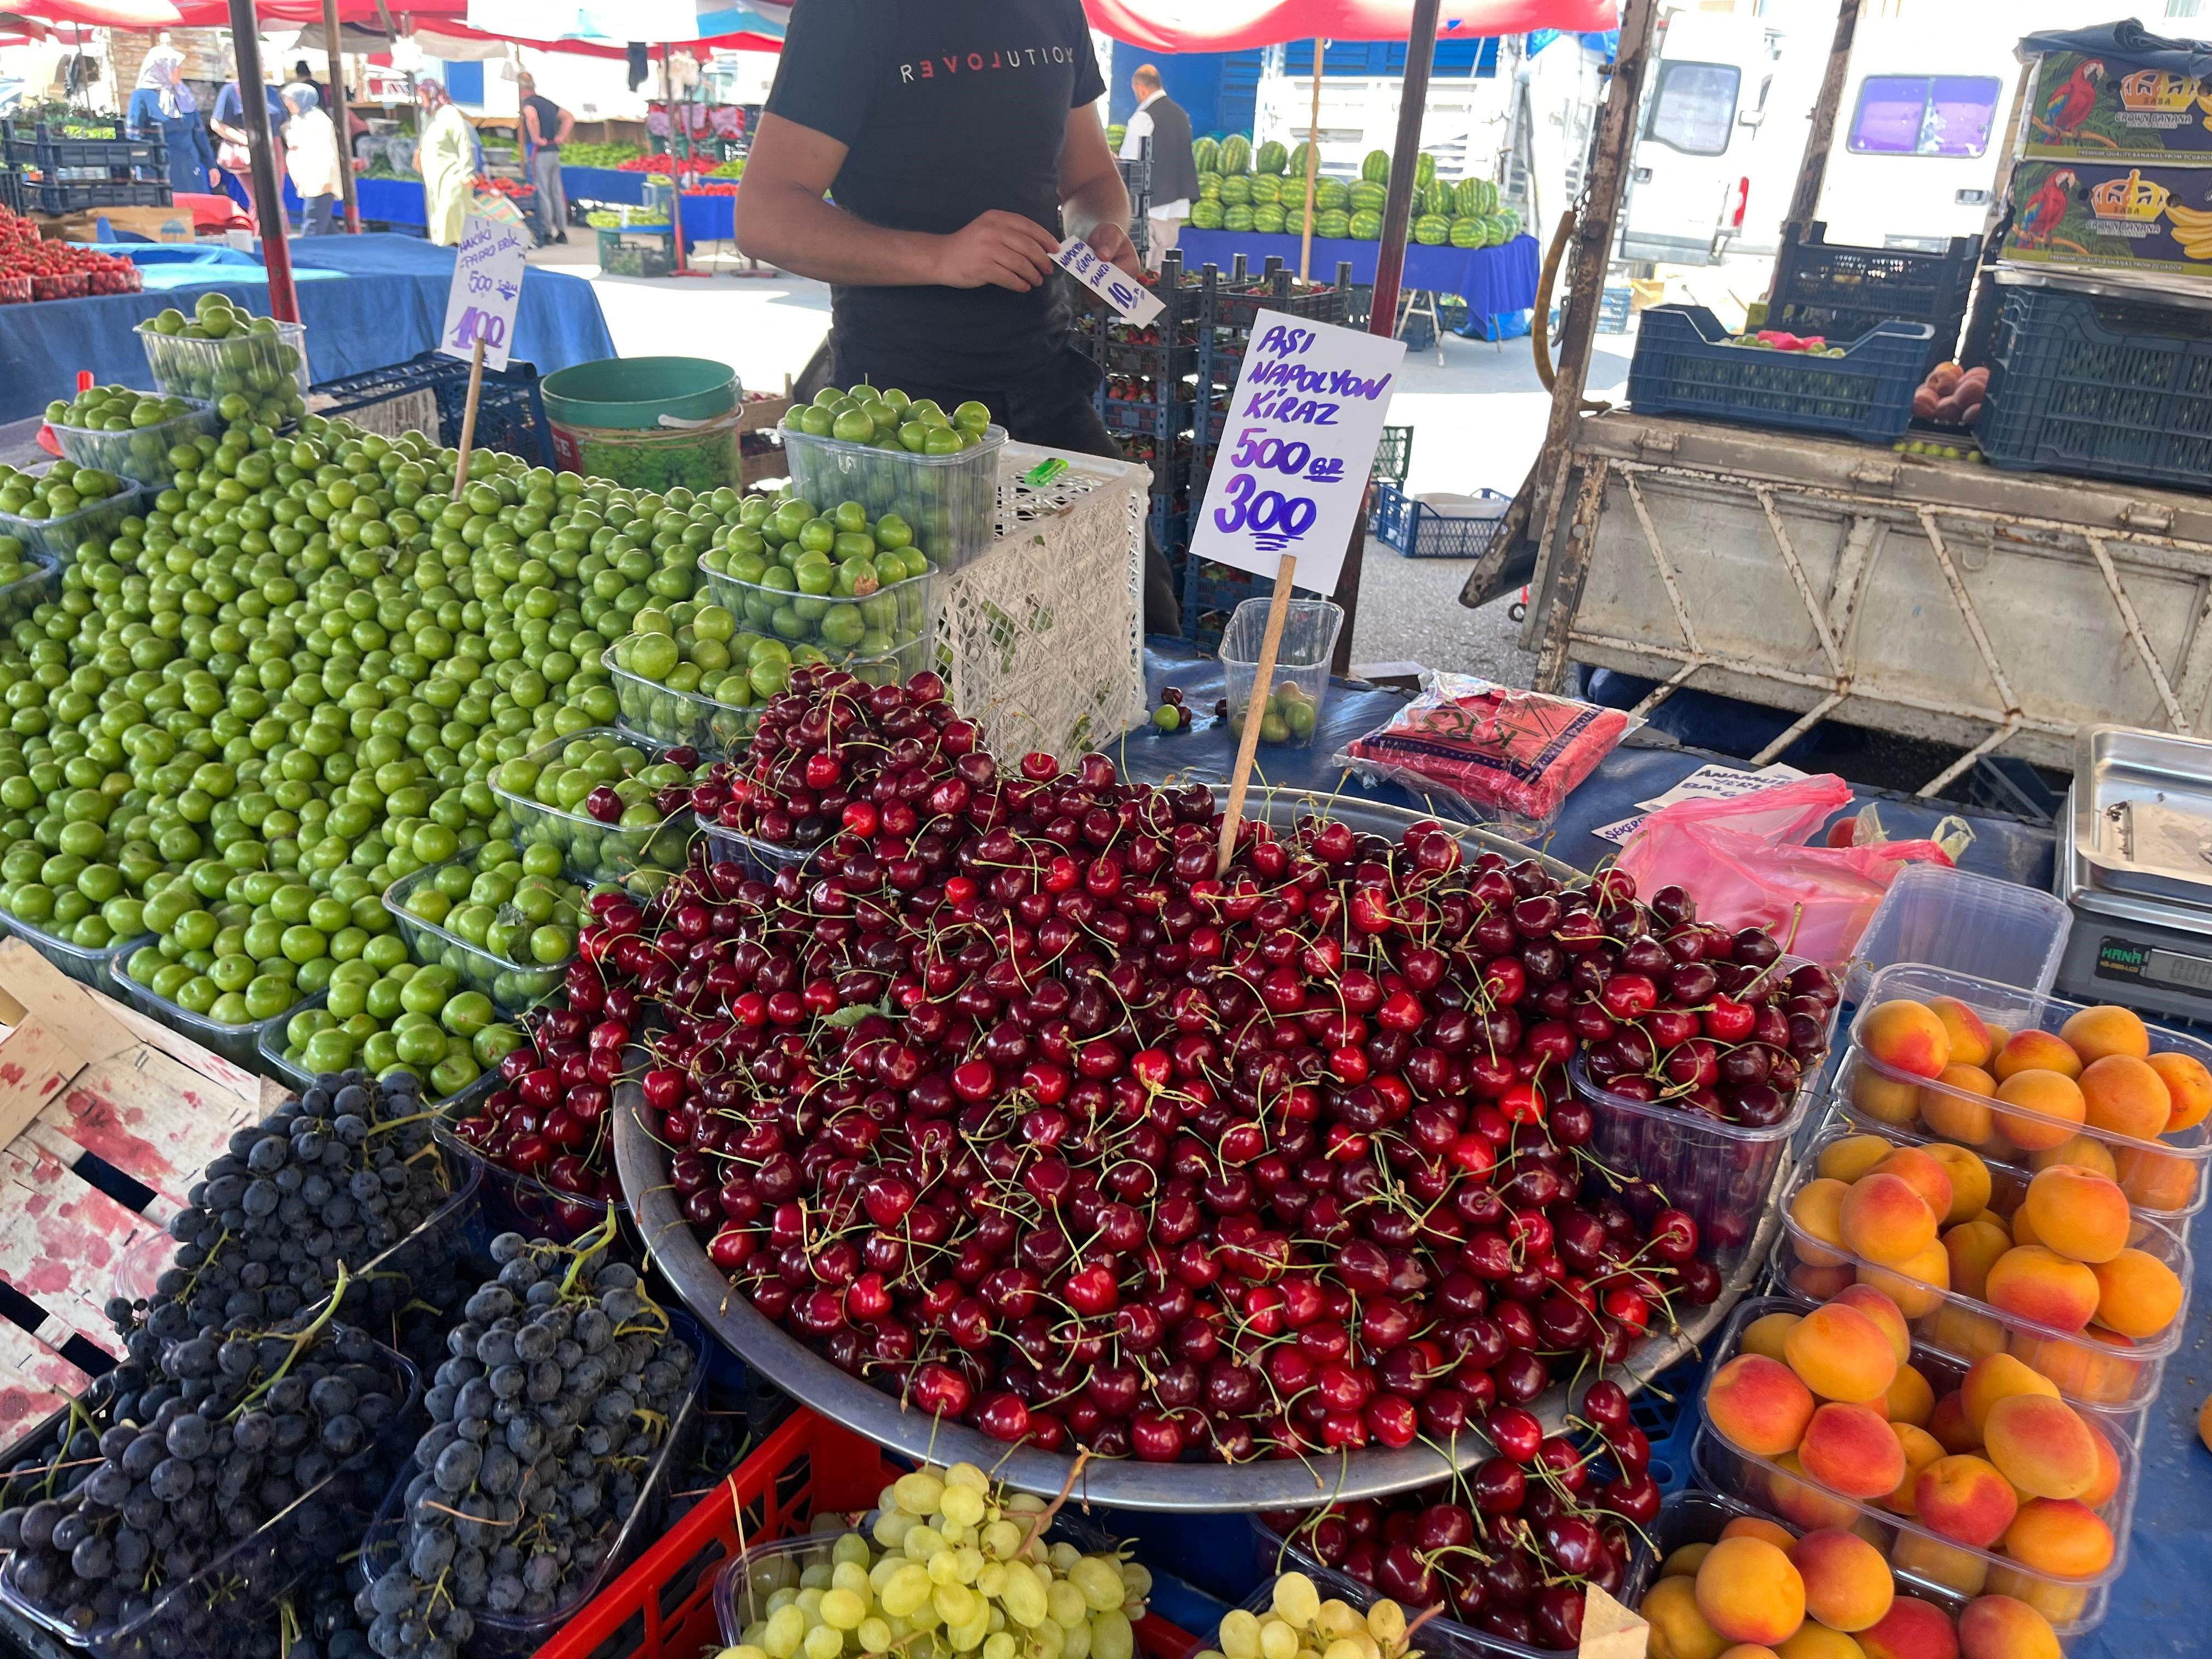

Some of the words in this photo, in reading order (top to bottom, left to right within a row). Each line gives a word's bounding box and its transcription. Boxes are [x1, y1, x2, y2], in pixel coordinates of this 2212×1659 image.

[900, 46, 1074, 83] REVOLUTION
[2115, 111, 2150, 123] CROWN
[2151, 112, 2192, 125] BANANA
[468, 270, 492, 293] 500
[1108, 282, 1133, 309] 10
[449, 306, 505, 349] 100
[1247, 360, 1392, 400] NAPOLYON
[1242, 388, 1340, 425] KİRAZ
[1231, 428, 1311, 475] 500
[1309, 457, 1345, 476] GR
[1214, 473, 1317, 536] 300
[2102, 947, 2142, 964] HANA
